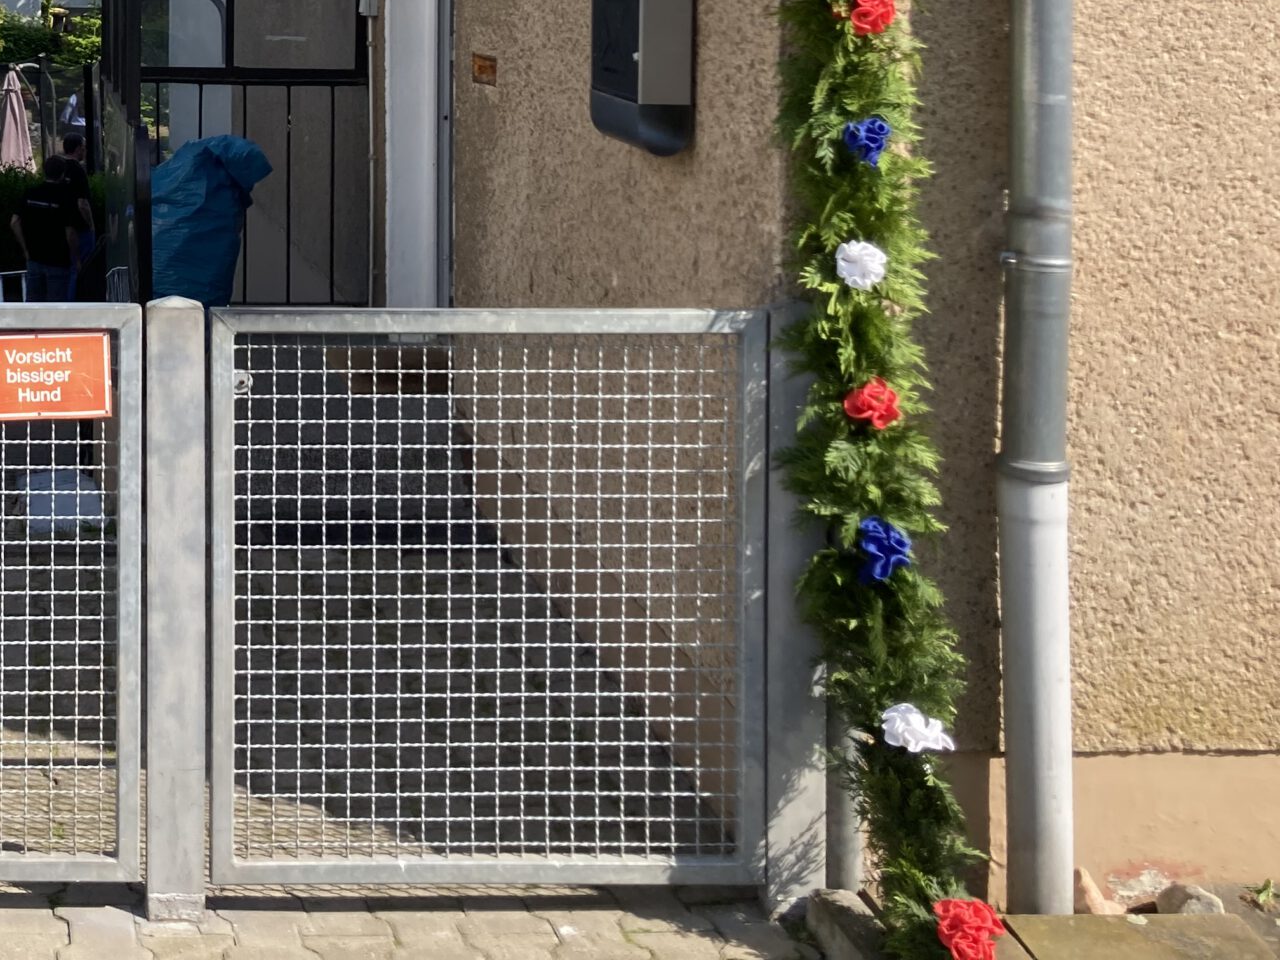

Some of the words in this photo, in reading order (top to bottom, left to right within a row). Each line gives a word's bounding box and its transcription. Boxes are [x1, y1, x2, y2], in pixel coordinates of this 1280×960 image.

[5, 348, 72, 364] Vorsicht
[6, 368, 71, 385] bissiger
[18, 387, 61, 402] Hund
